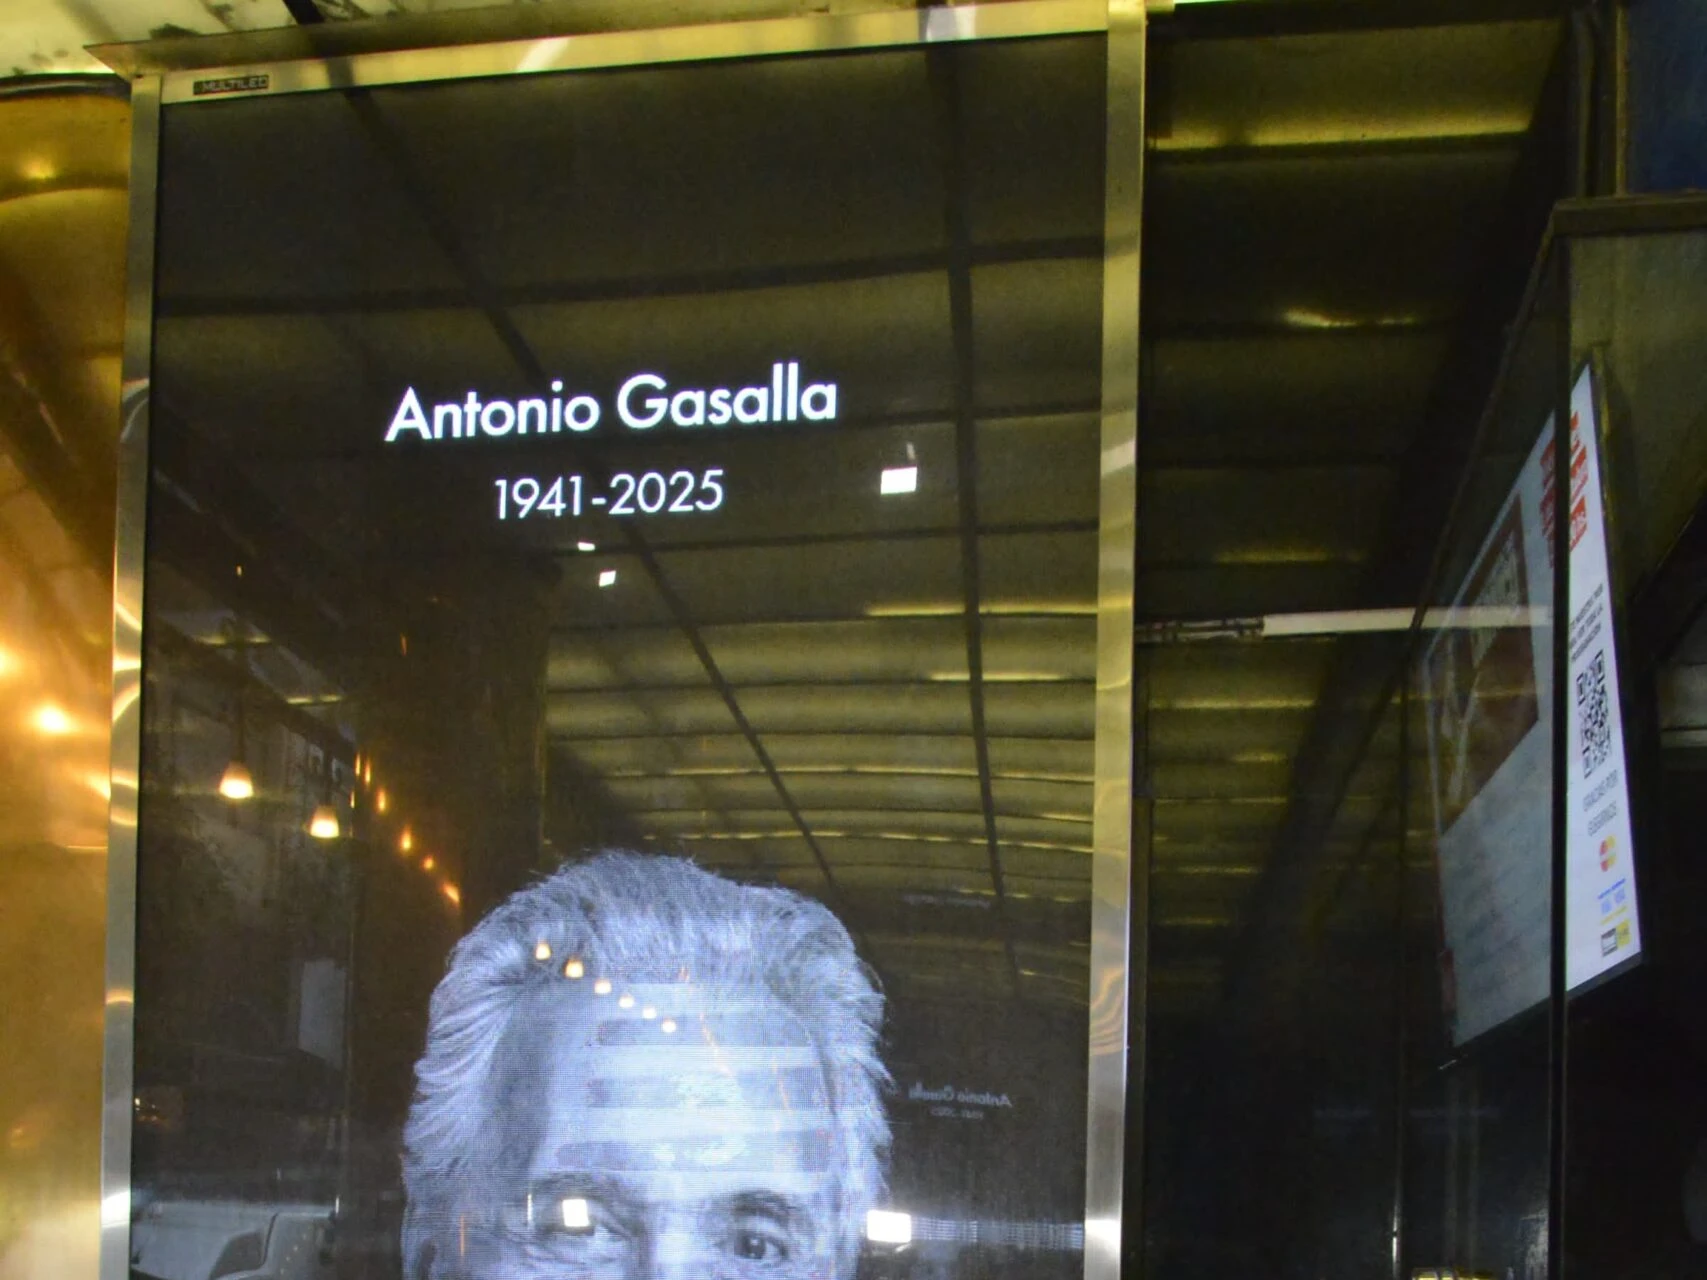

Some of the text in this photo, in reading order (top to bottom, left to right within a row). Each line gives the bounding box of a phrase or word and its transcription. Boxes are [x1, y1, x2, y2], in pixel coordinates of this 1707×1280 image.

[384, 361, 838, 442] Antonio Gasalla
[494, 468, 725, 520] 1941-2025
